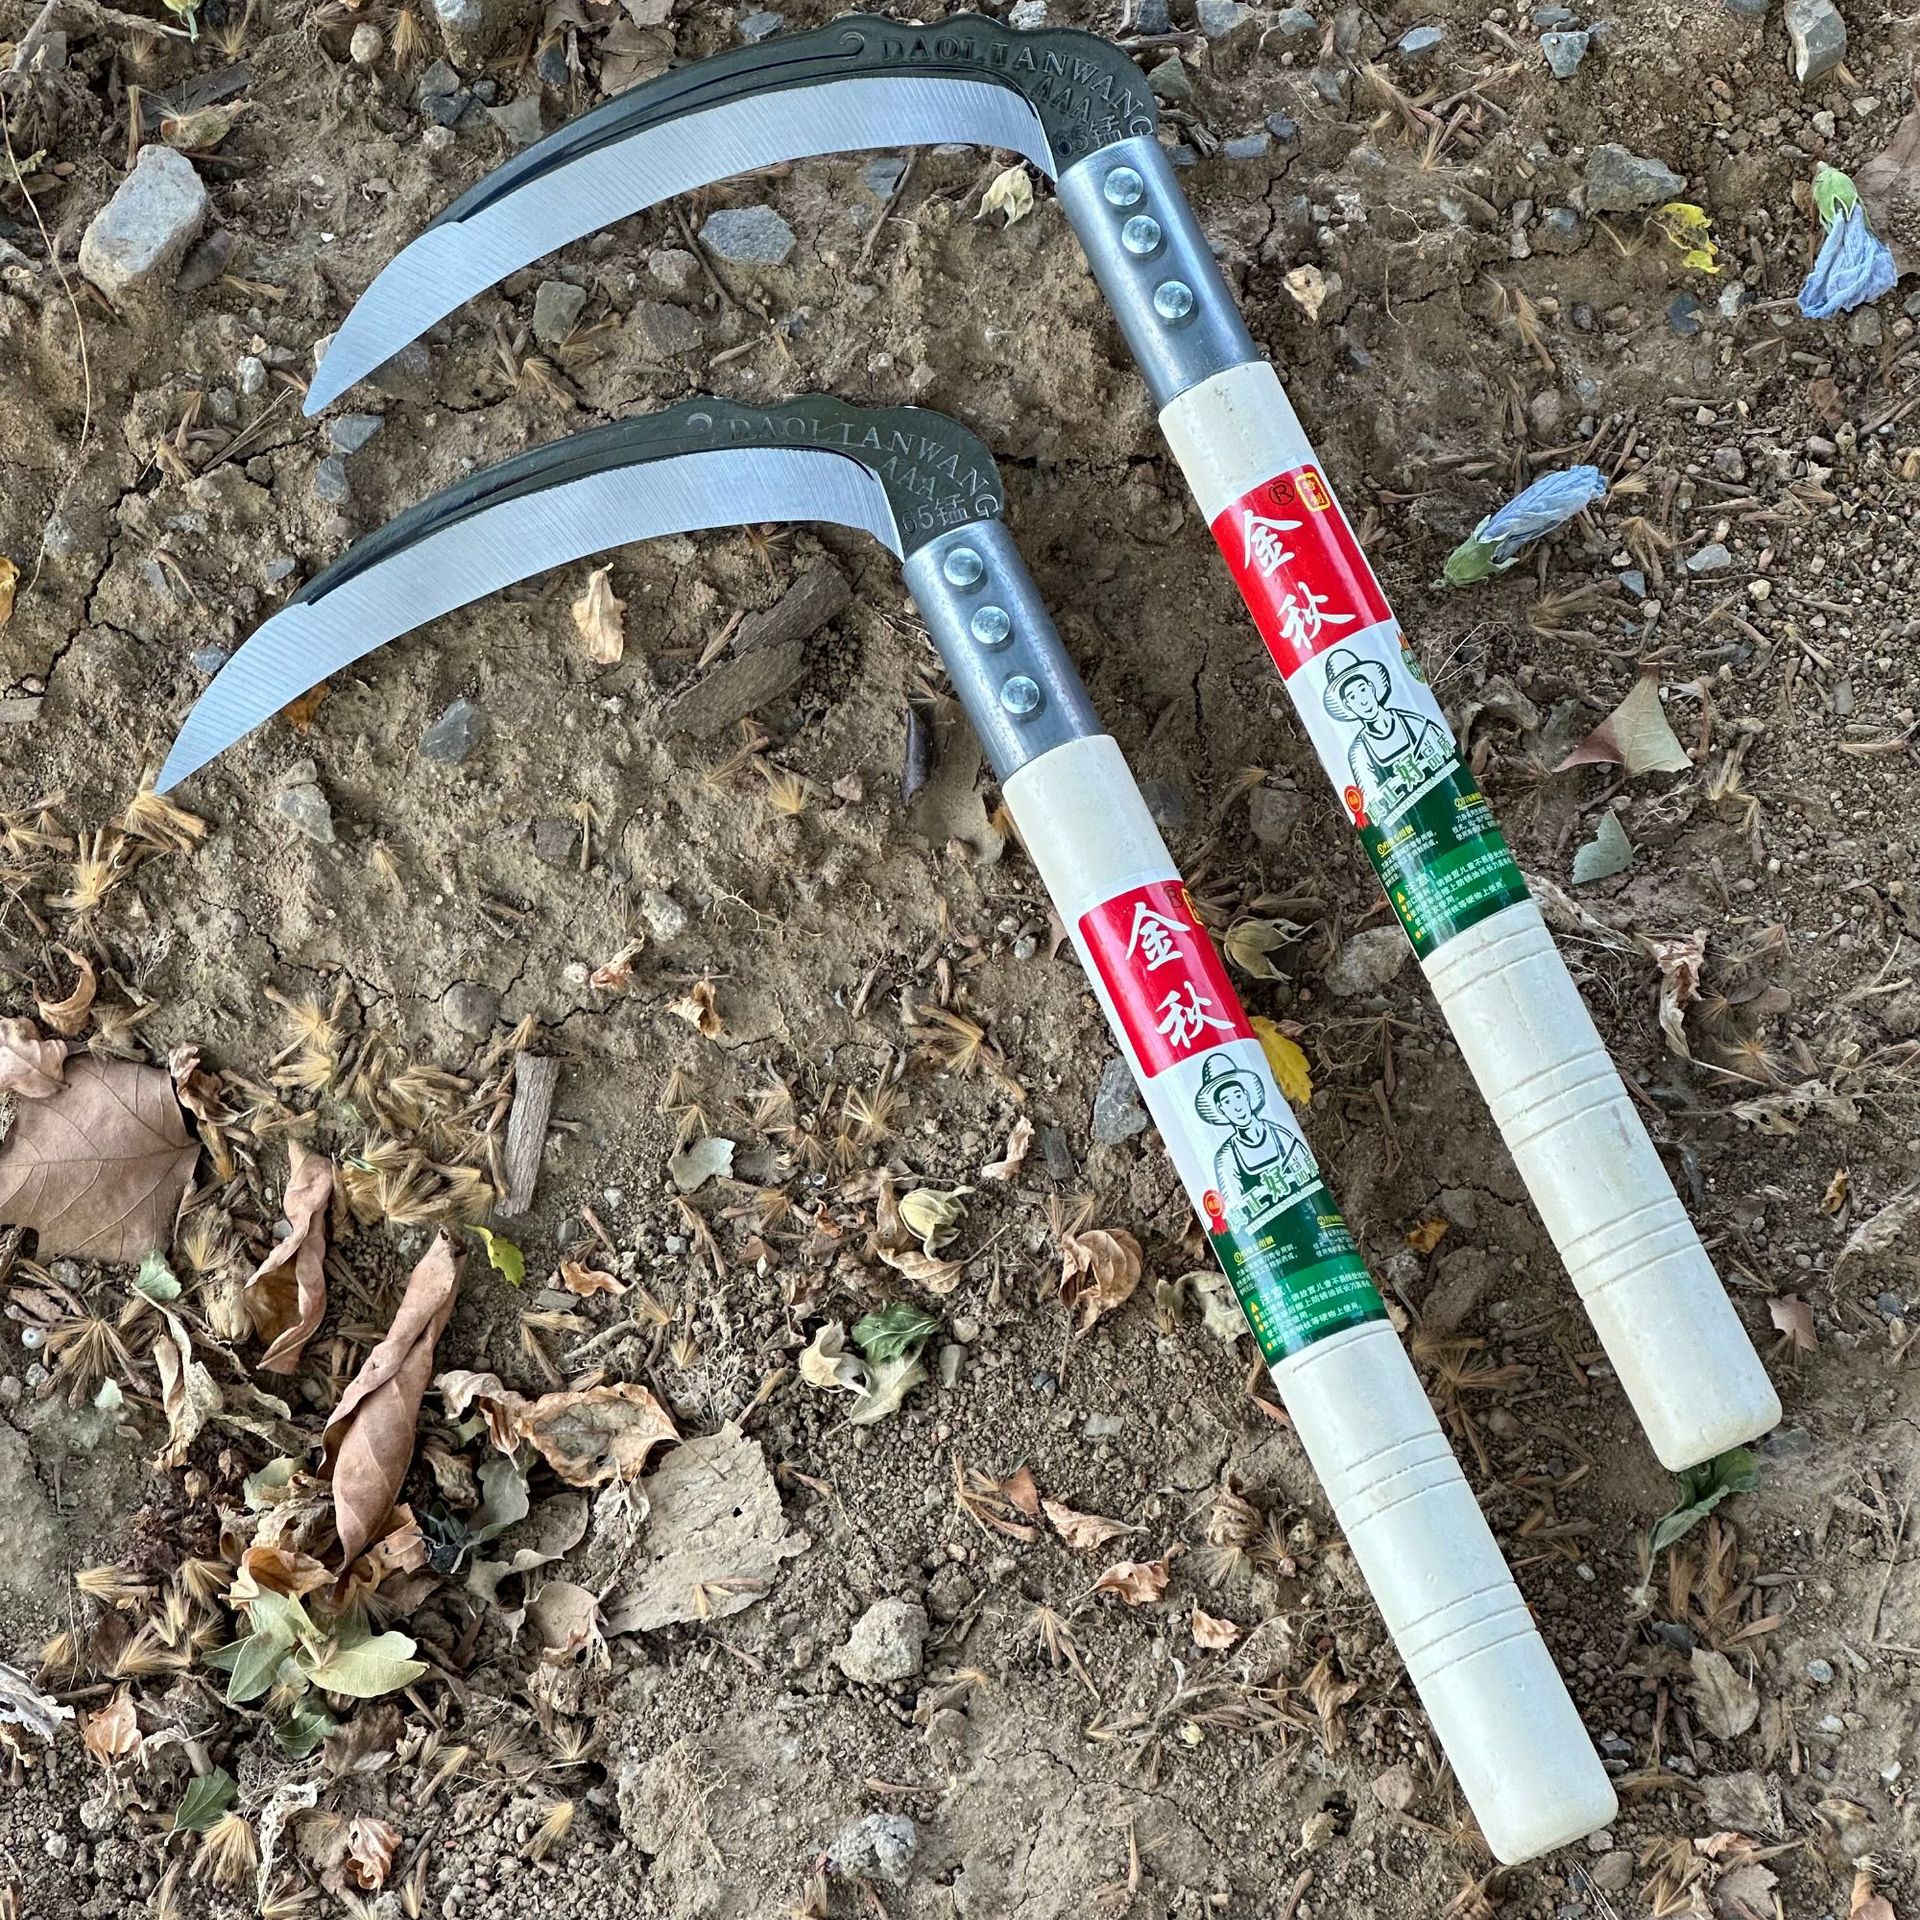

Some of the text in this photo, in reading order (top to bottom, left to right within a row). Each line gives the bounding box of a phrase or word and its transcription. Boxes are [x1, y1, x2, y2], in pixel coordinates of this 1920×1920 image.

[1029, 76, 1091, 124] AAA
[878, 456, 936, 502] AAA
[1242, 509, 1356, 650] 金秋
[1126, 901, 1236, 1049] 金秋
